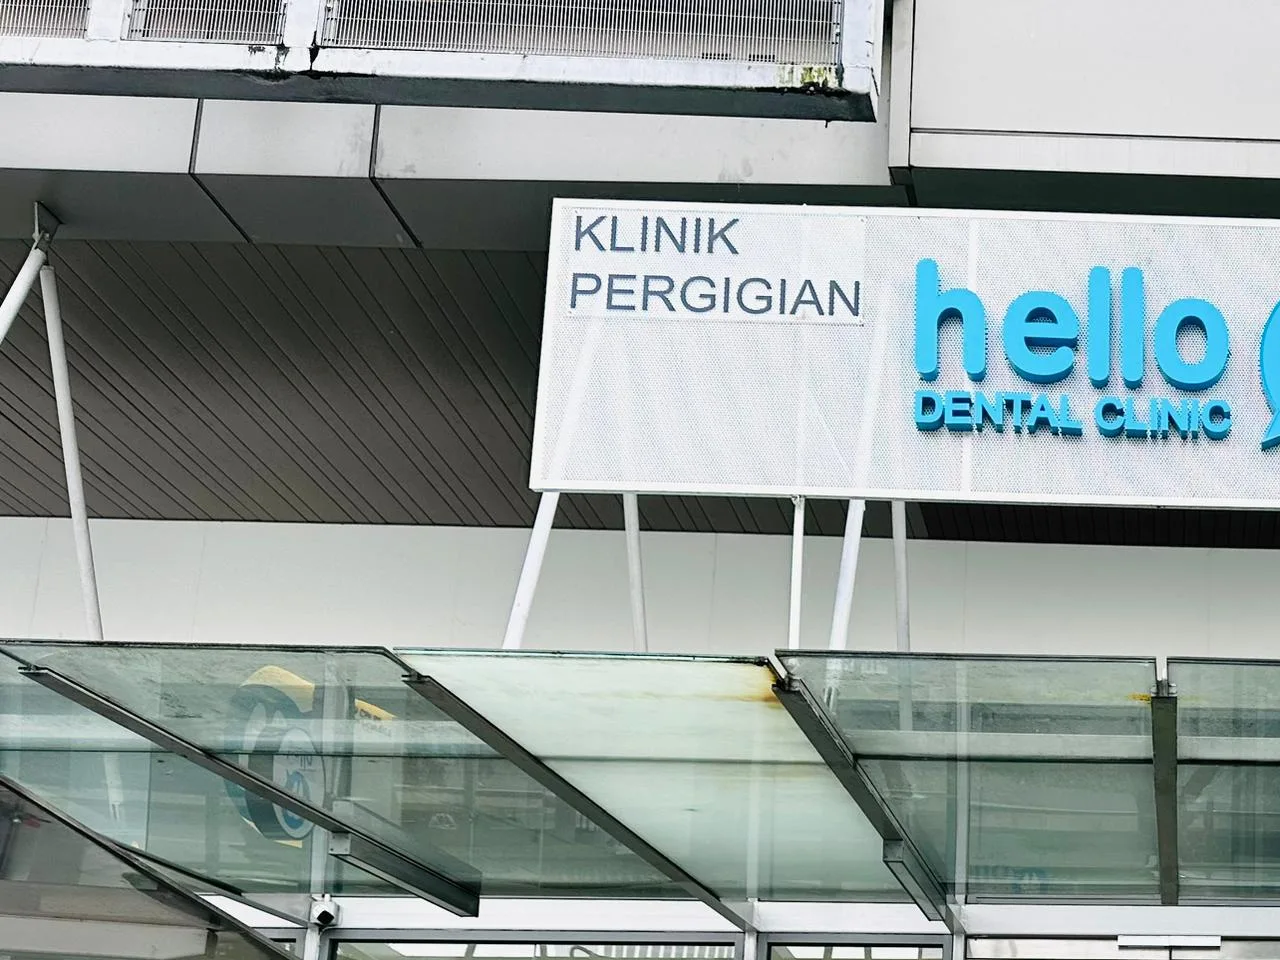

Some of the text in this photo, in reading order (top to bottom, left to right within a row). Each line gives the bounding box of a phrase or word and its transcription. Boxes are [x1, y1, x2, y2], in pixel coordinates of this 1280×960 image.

[574, 215, 740, 255] KLINIK
[570, 272, 861, 317] PERGIGIAN
[915, 257, 1231, 392] hello
[914, 391, 1232, 440] DENTAL CLINIC
